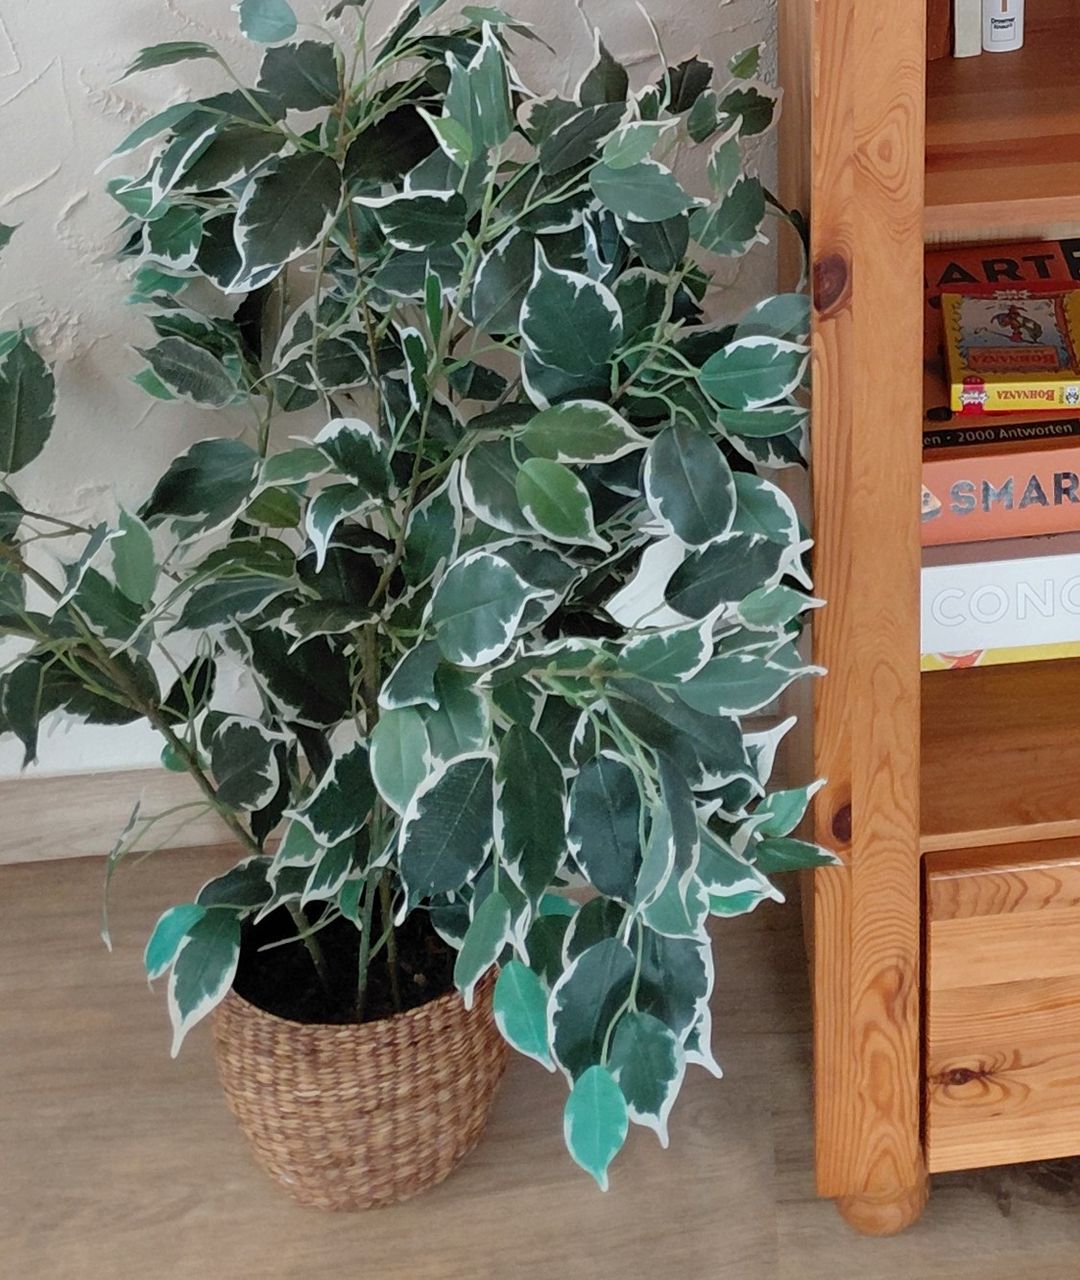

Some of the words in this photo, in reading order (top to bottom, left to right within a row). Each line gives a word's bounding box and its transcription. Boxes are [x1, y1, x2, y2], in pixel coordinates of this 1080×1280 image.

[971, 352, 1057, 366] BOHNANZA
[996, 389, 1056, 402] BOHNANZA
[957, 429, 996, 443] 2000
[998, 422, 1074, 440] Antworten
